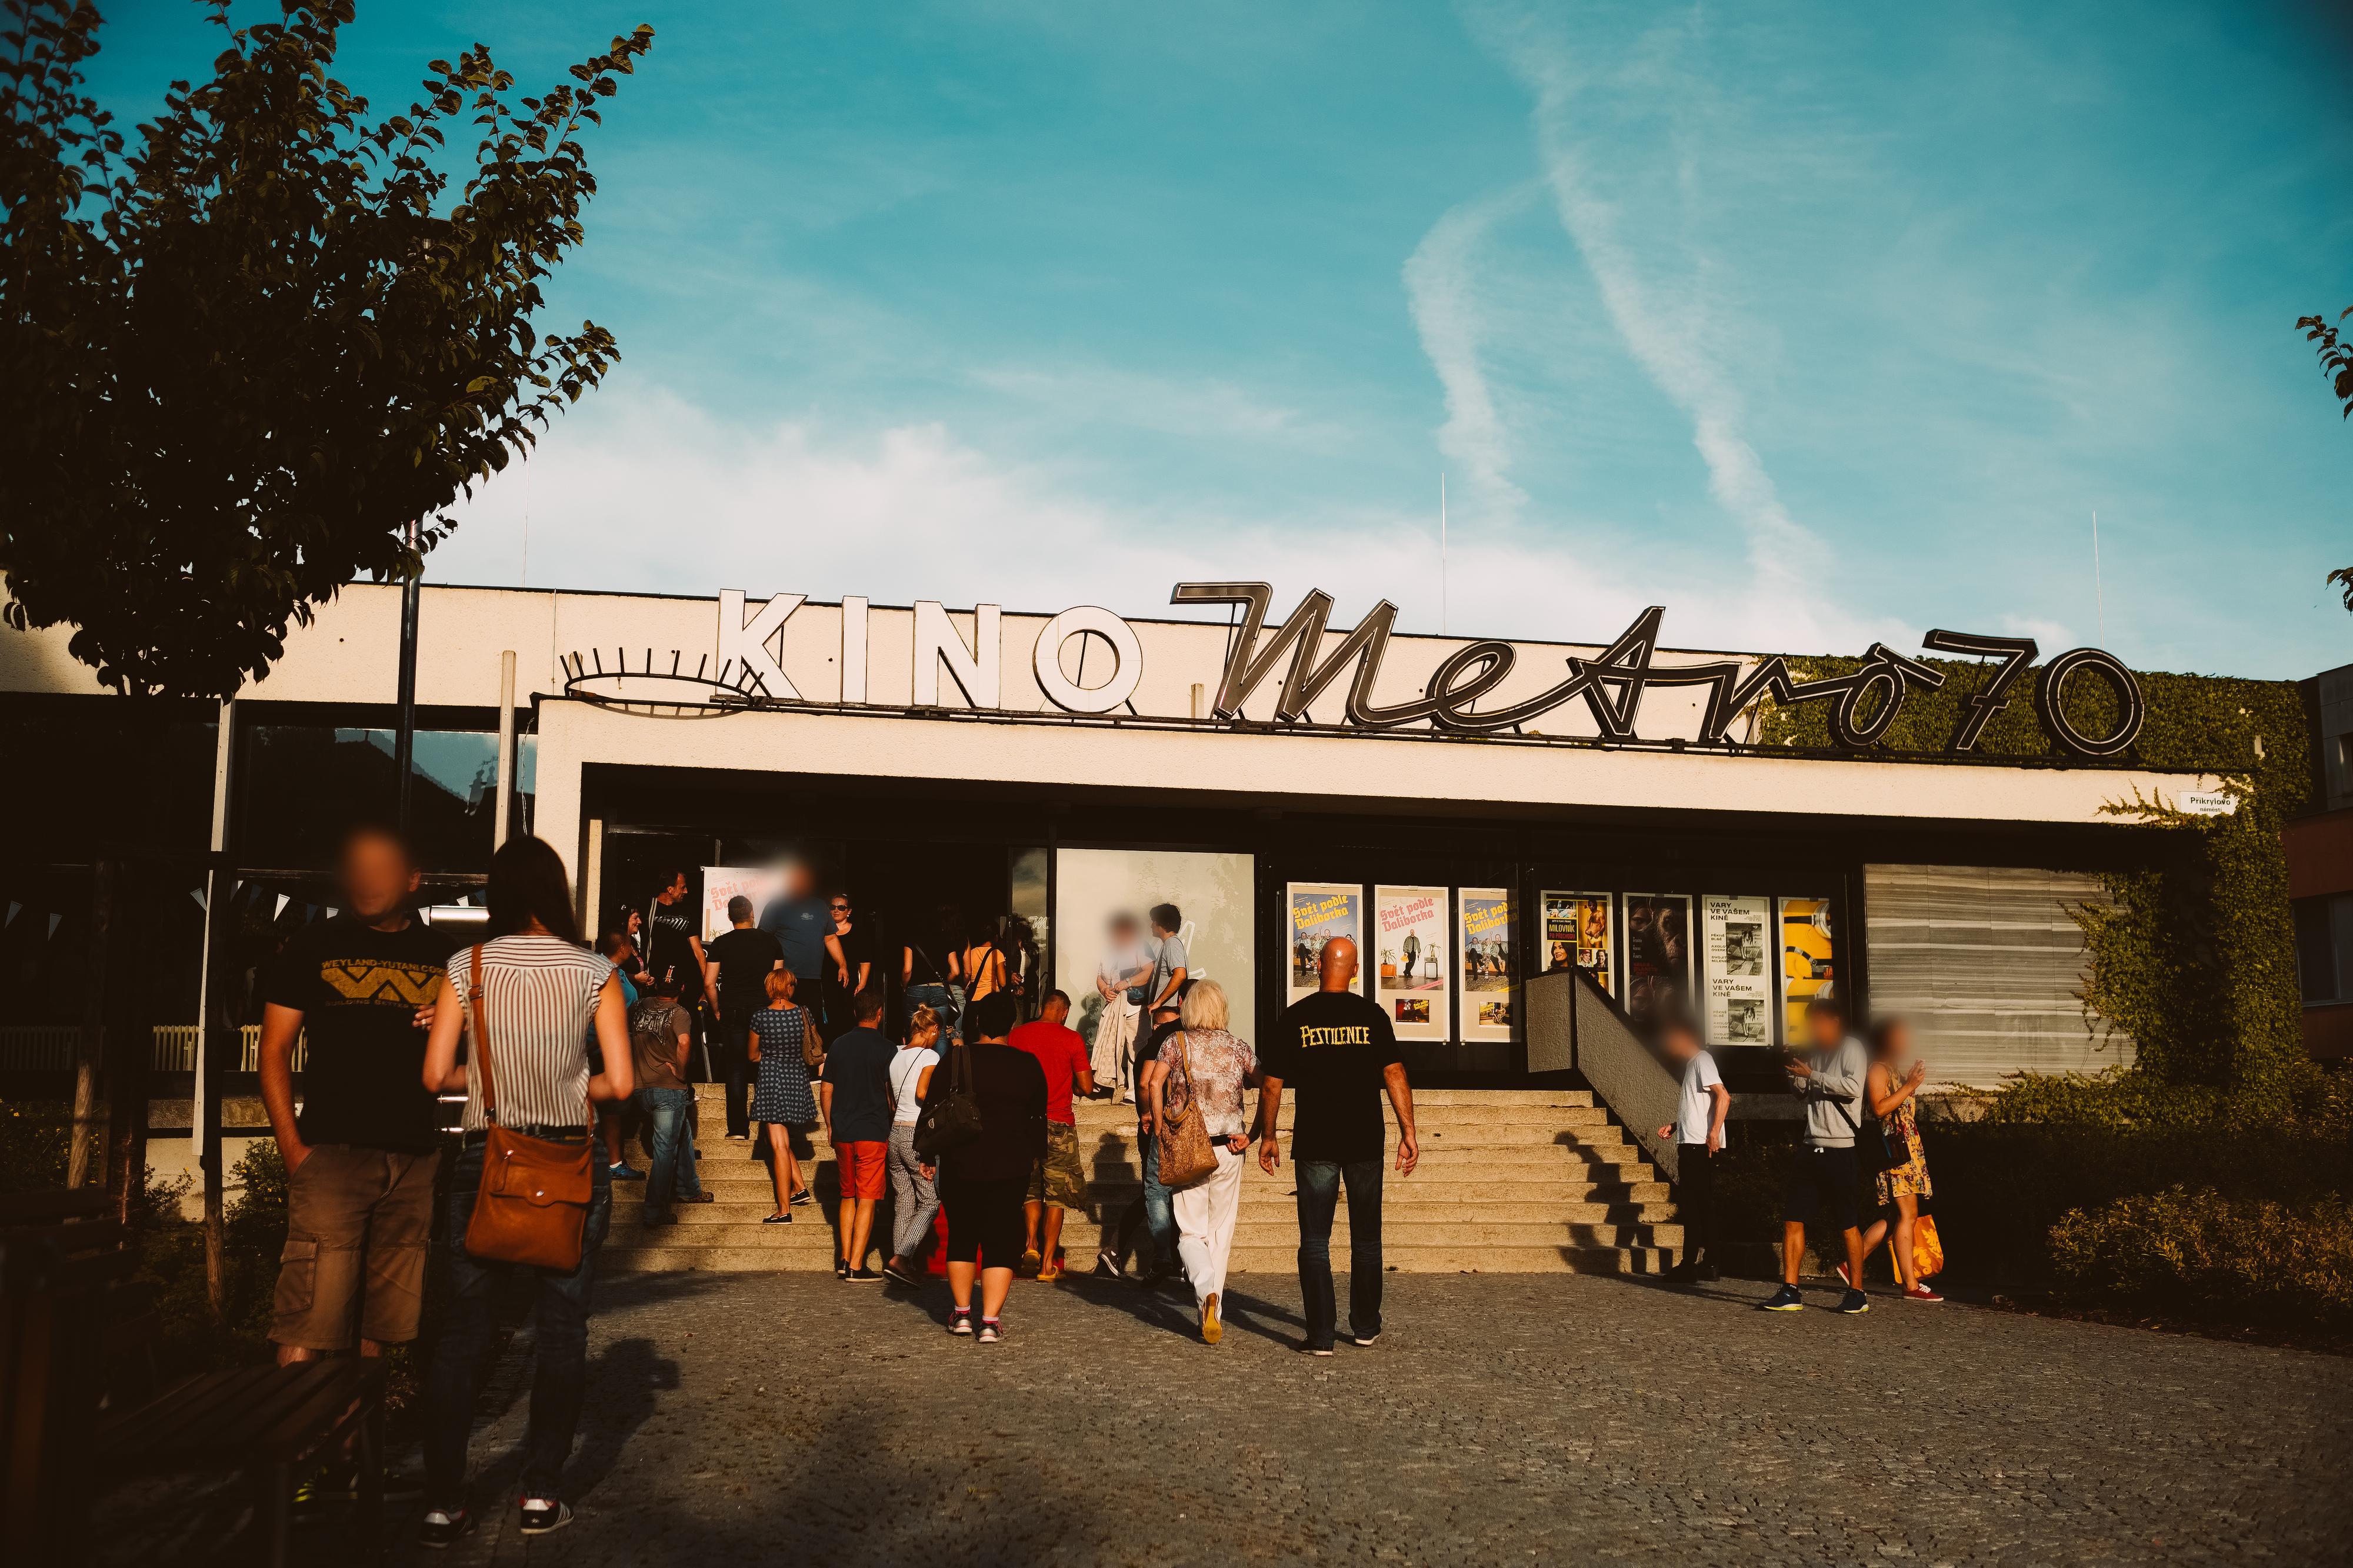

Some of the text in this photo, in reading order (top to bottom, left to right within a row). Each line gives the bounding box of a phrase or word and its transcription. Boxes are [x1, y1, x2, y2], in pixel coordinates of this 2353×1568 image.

[716, 582, 2144, 756] KINO Metro 70
[1293, 902, 1318, 918] Svět
[1319, 895, 1349, 913] podle
[1380, 897, 1434, 921] Svět podle
[1464, 907, 1489, 924] Svět
[1294, 907, 1349, 929] Daliborka
[1381, 910, 1435, 932] Daliborka
[1549, 923, 1575, 933] MILOVNÍK
[321, 959, 420, 969] WEYLAND-YUTANI
[1299, 1025, 1371, 1047] PESTILENCE
